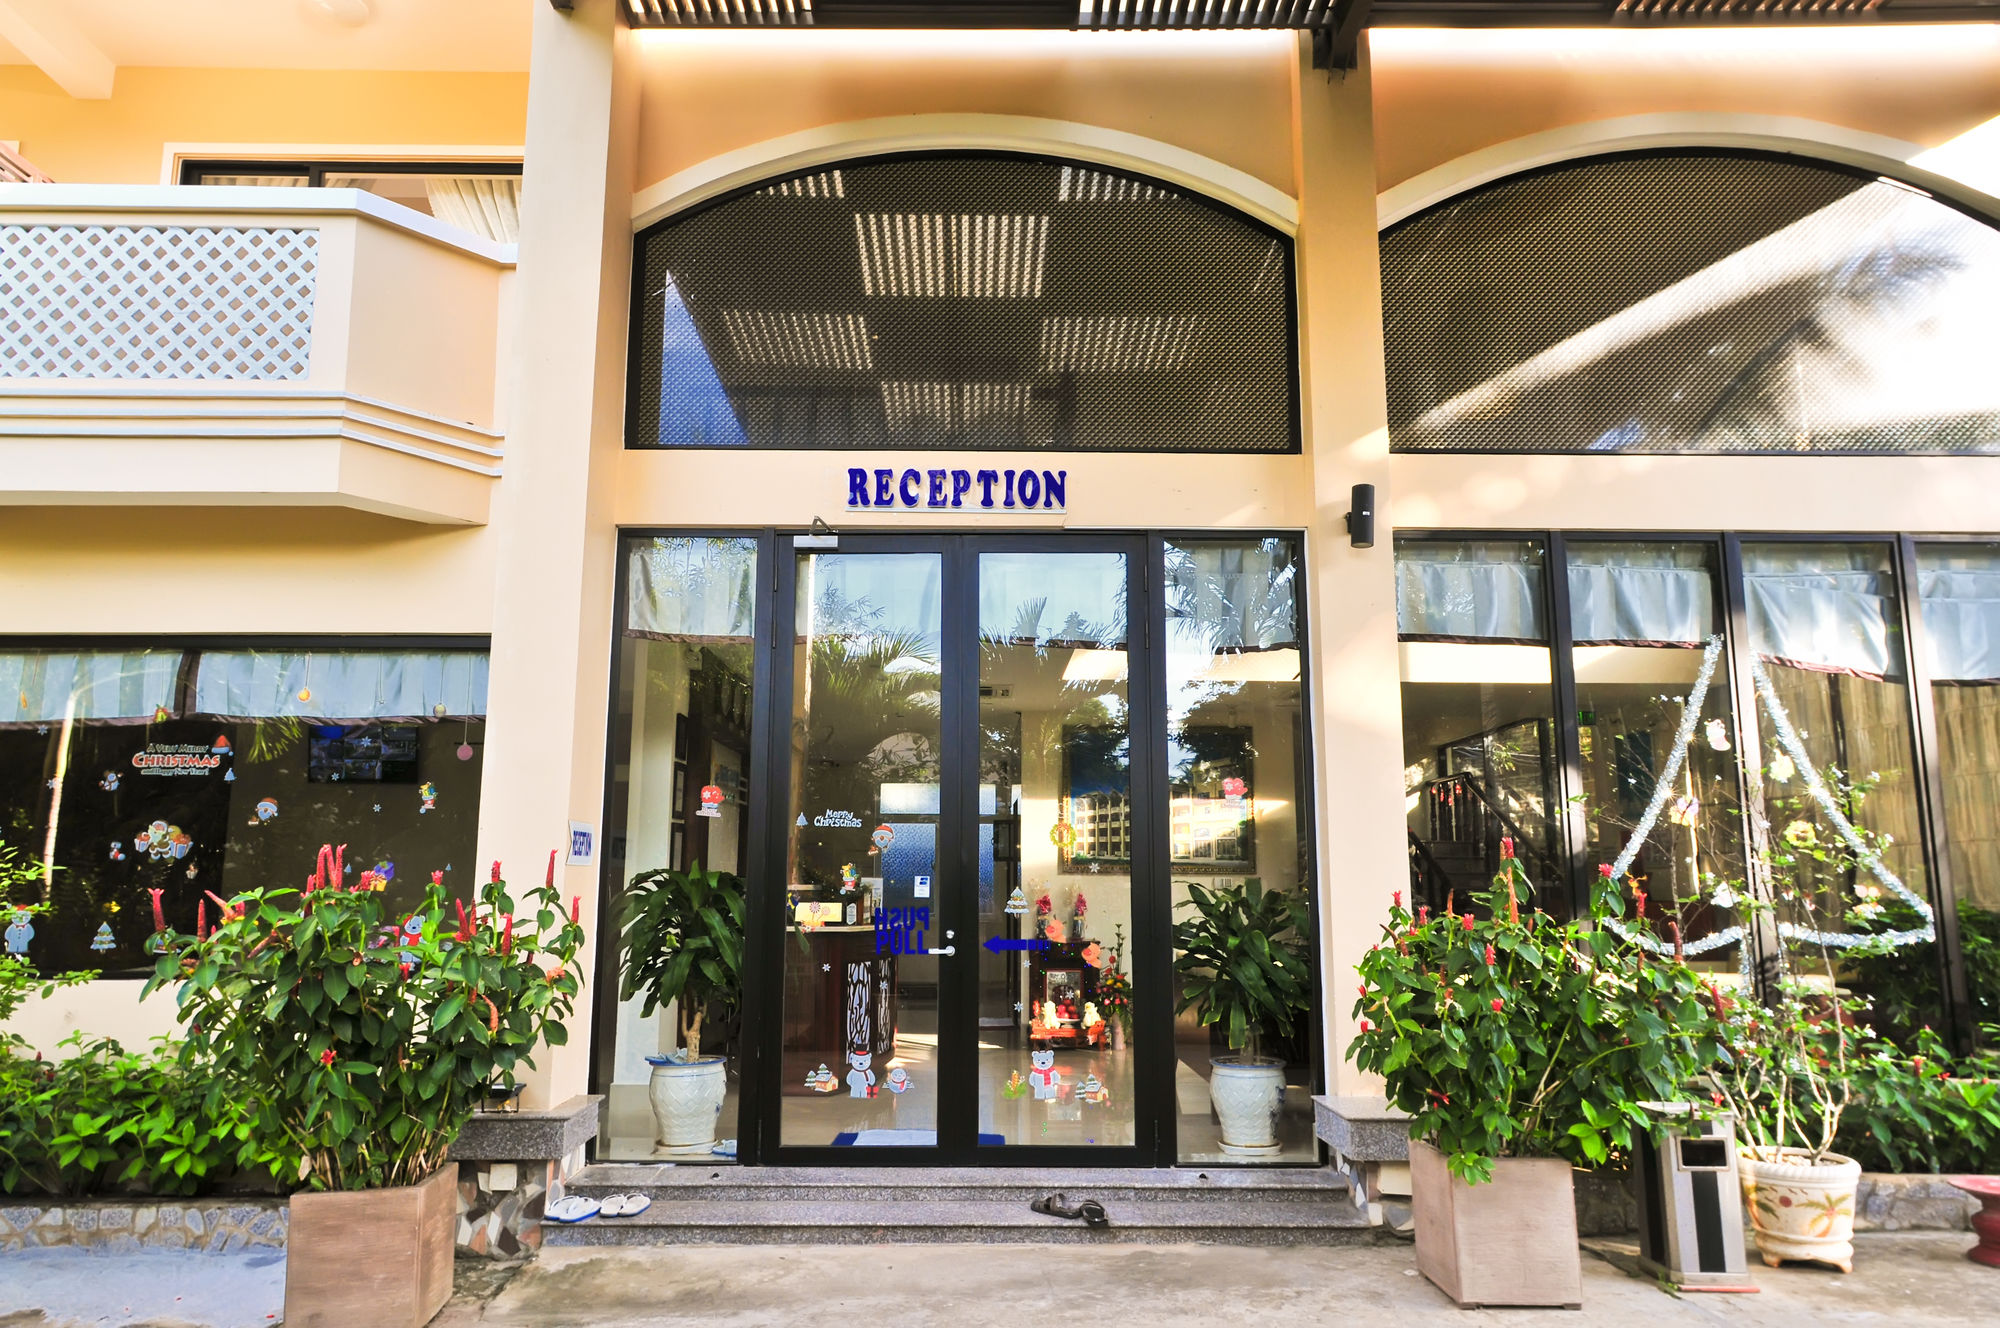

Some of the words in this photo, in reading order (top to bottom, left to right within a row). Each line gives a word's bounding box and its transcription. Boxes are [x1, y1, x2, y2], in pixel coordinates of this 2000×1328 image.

[847, 468, 1067, 509] RECEPTION
[147, 743, 155, 752] A
[132, 751, 220, 768] CHRISTMAS
[825, 808, 853, 819] Merry
[814, 815, 862, 828] Christmas
[875, 930, 929, 955] PULL
